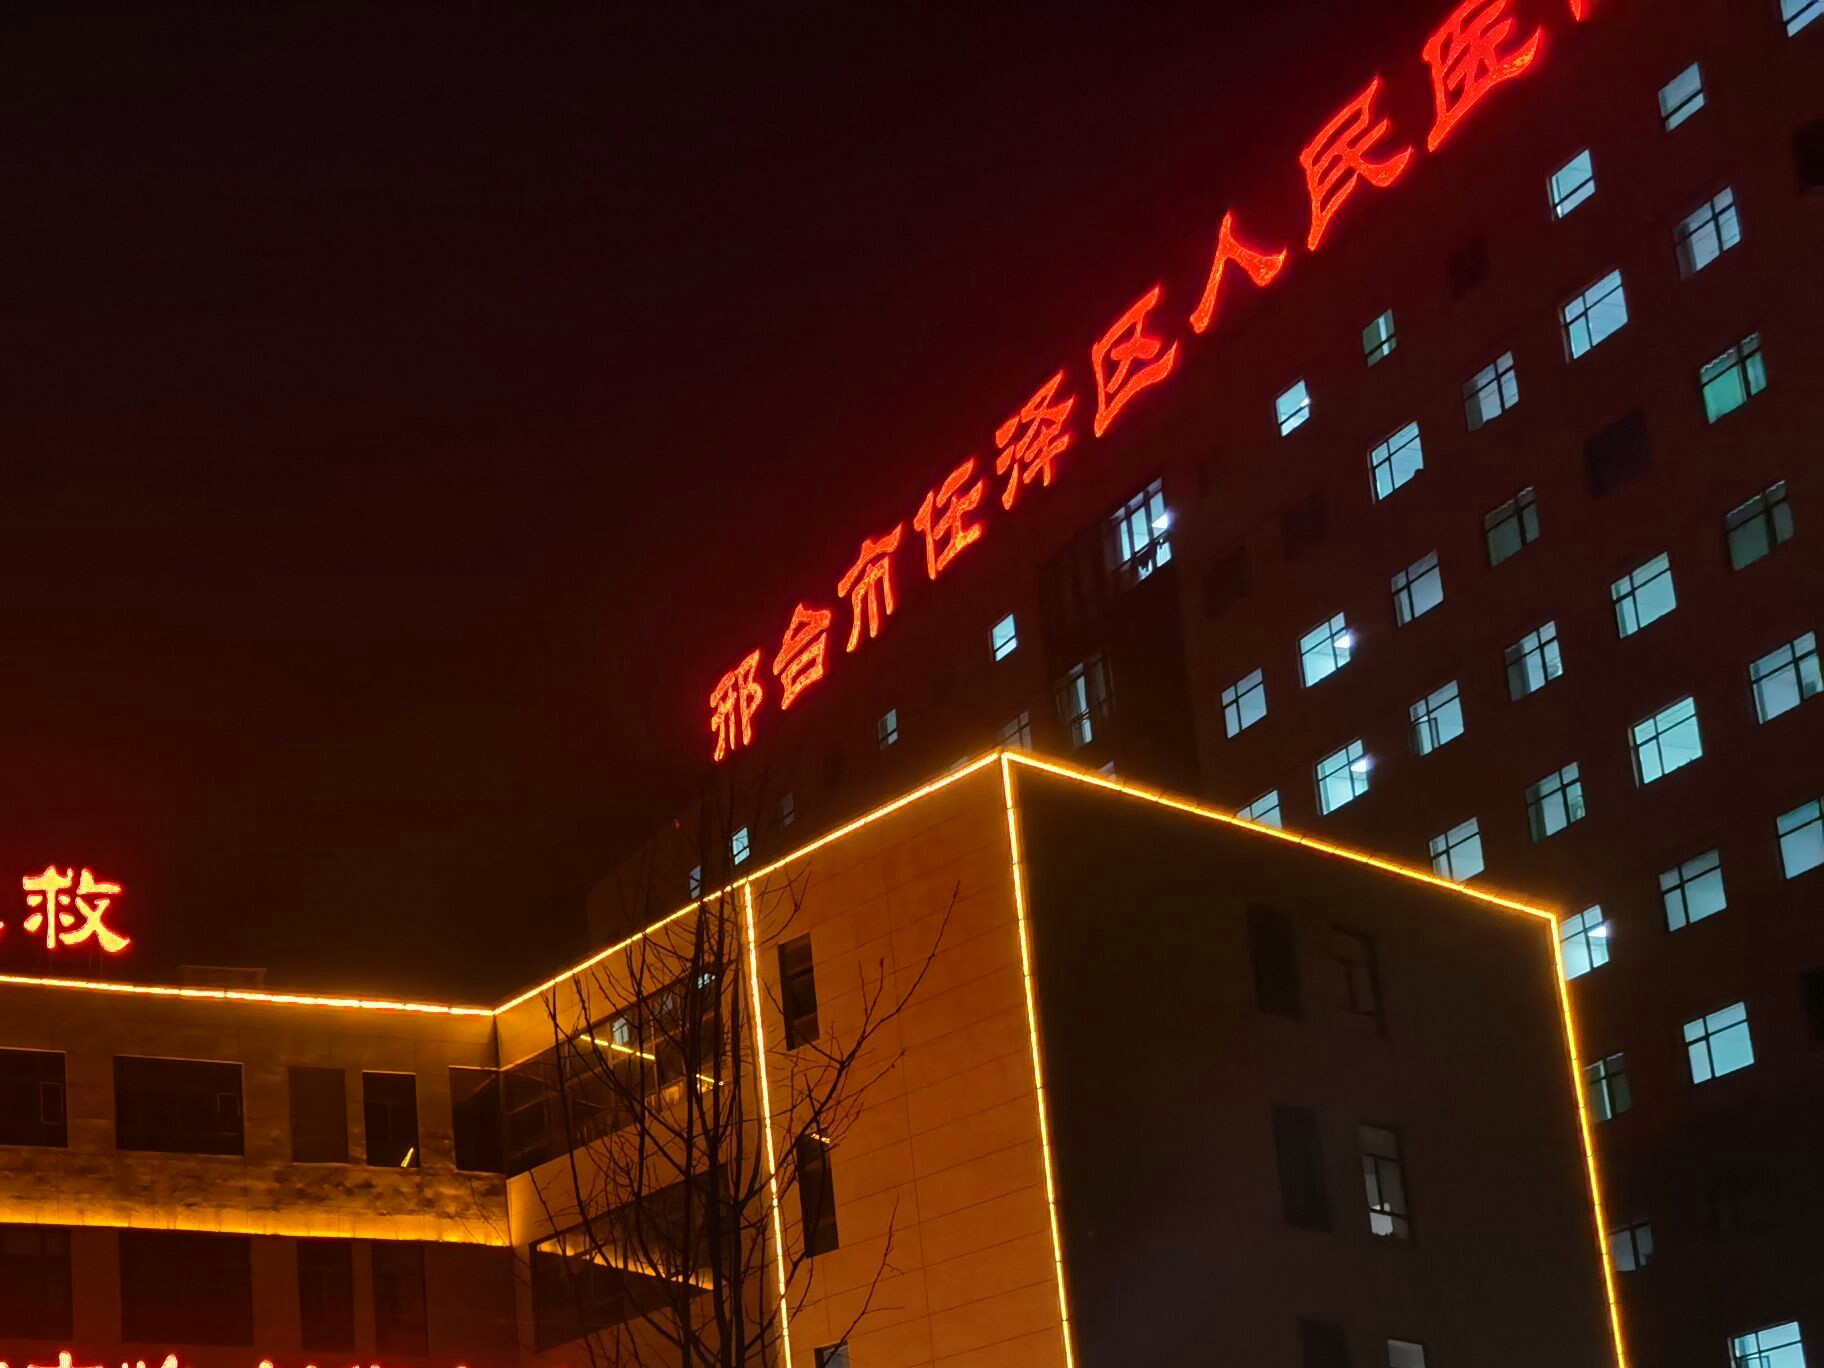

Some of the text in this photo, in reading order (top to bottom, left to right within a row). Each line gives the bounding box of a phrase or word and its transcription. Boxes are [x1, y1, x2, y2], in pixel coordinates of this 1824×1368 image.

[709, 0, 1583, 762] 邢台市任泽区人民医
